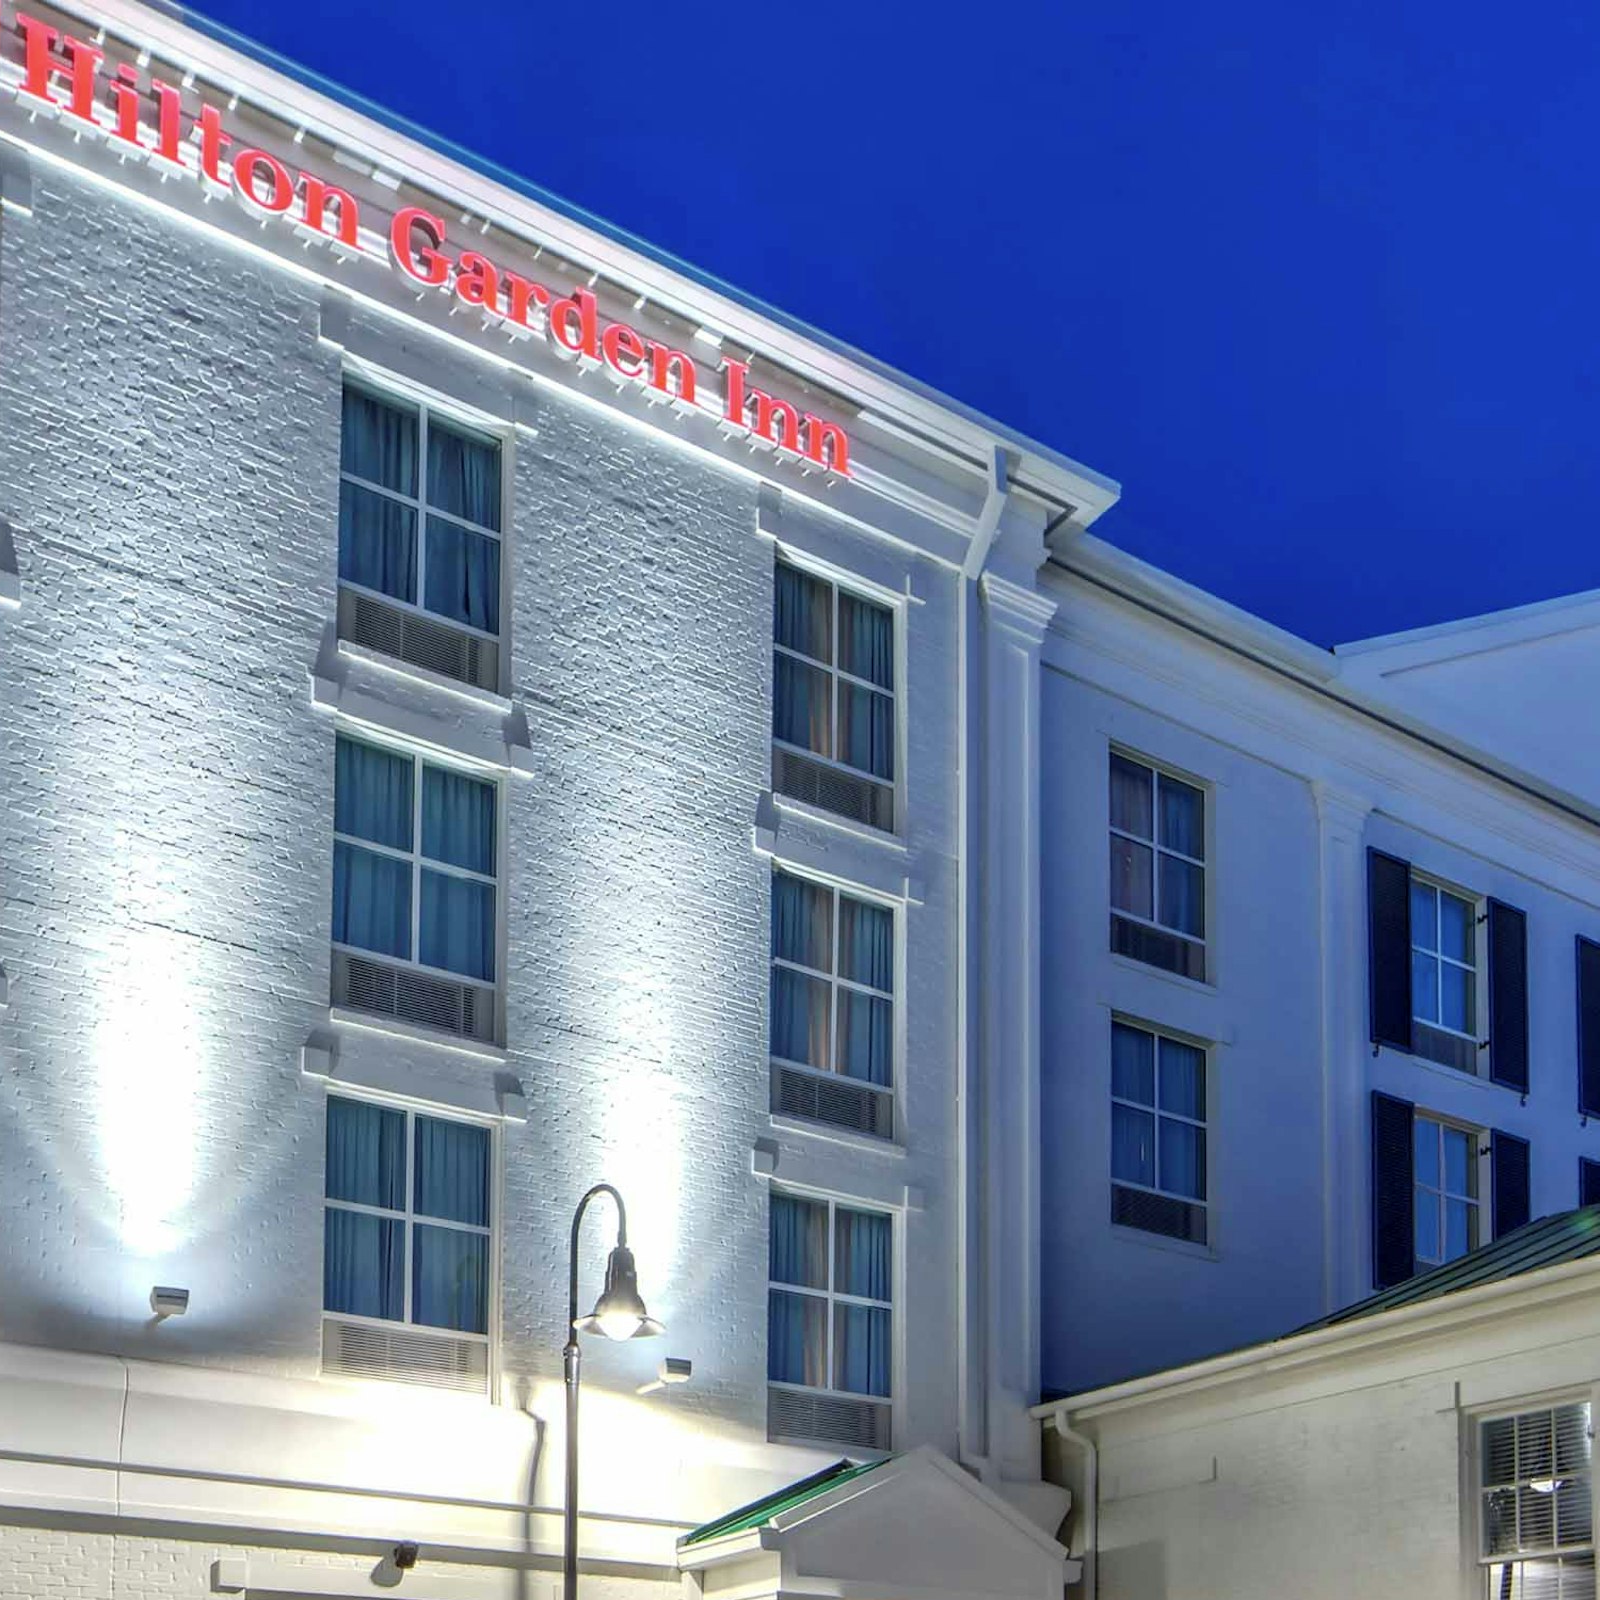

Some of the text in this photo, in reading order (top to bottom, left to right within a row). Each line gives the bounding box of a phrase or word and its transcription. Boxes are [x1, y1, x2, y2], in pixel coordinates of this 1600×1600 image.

[15, 12, 854, 479] Hilton Garden Inn
